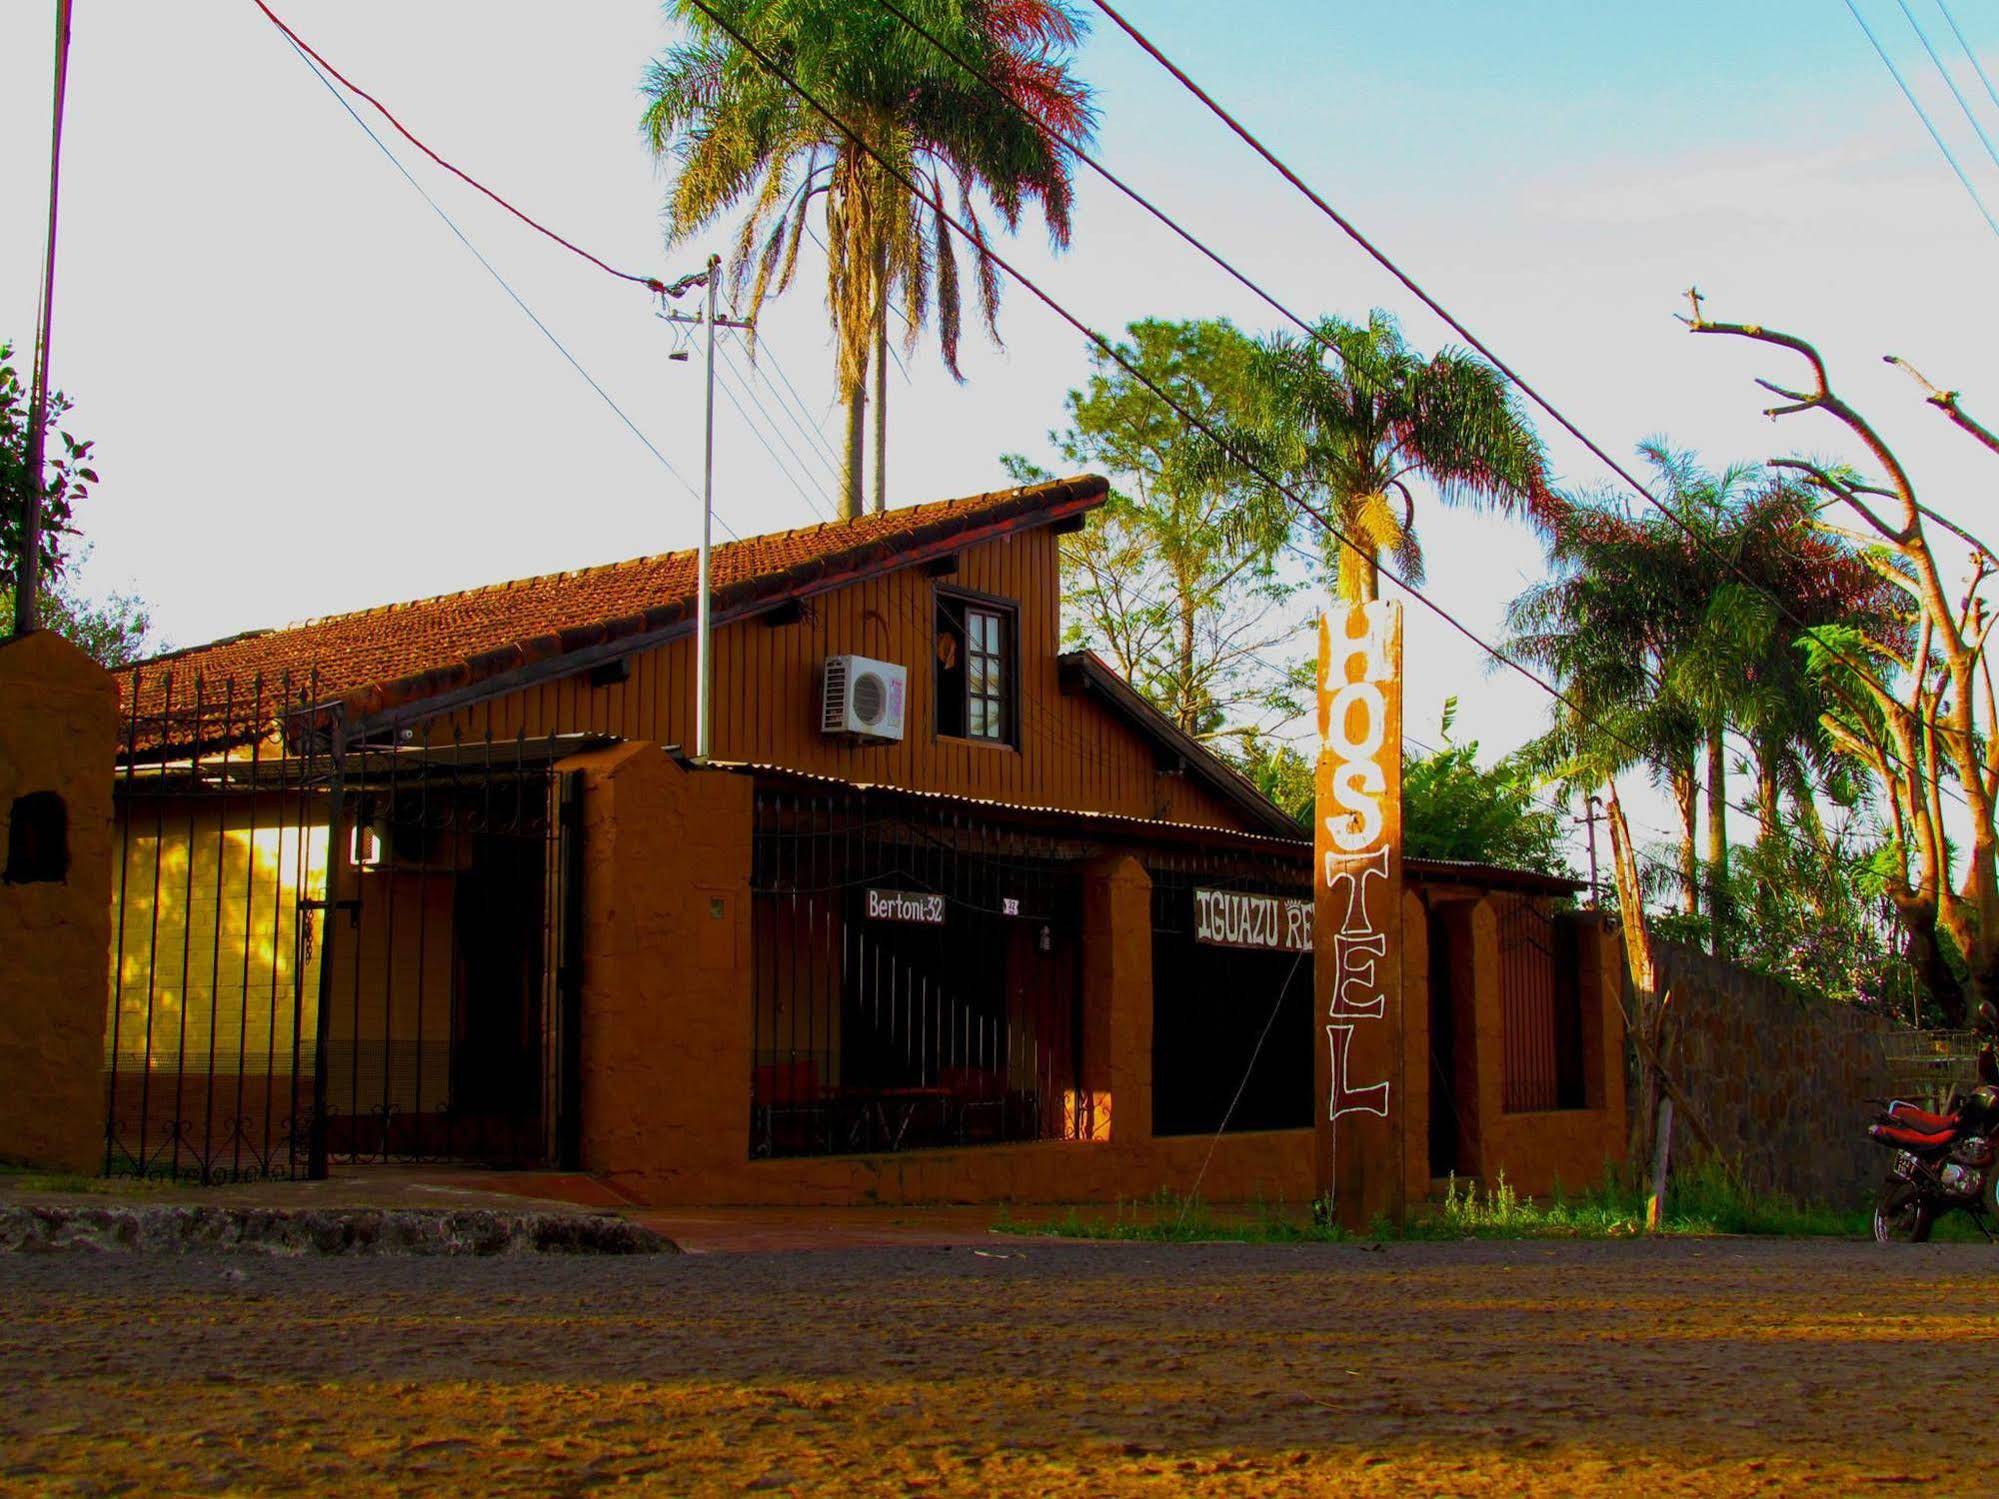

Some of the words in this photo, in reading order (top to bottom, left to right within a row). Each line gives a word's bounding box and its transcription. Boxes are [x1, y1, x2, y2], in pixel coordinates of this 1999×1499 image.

[1196, 891, 1278, 946] IGUAZU
[1286, 902, 1314, 950] RE
[1325, 601, 1396, 1120] HOSTEL
